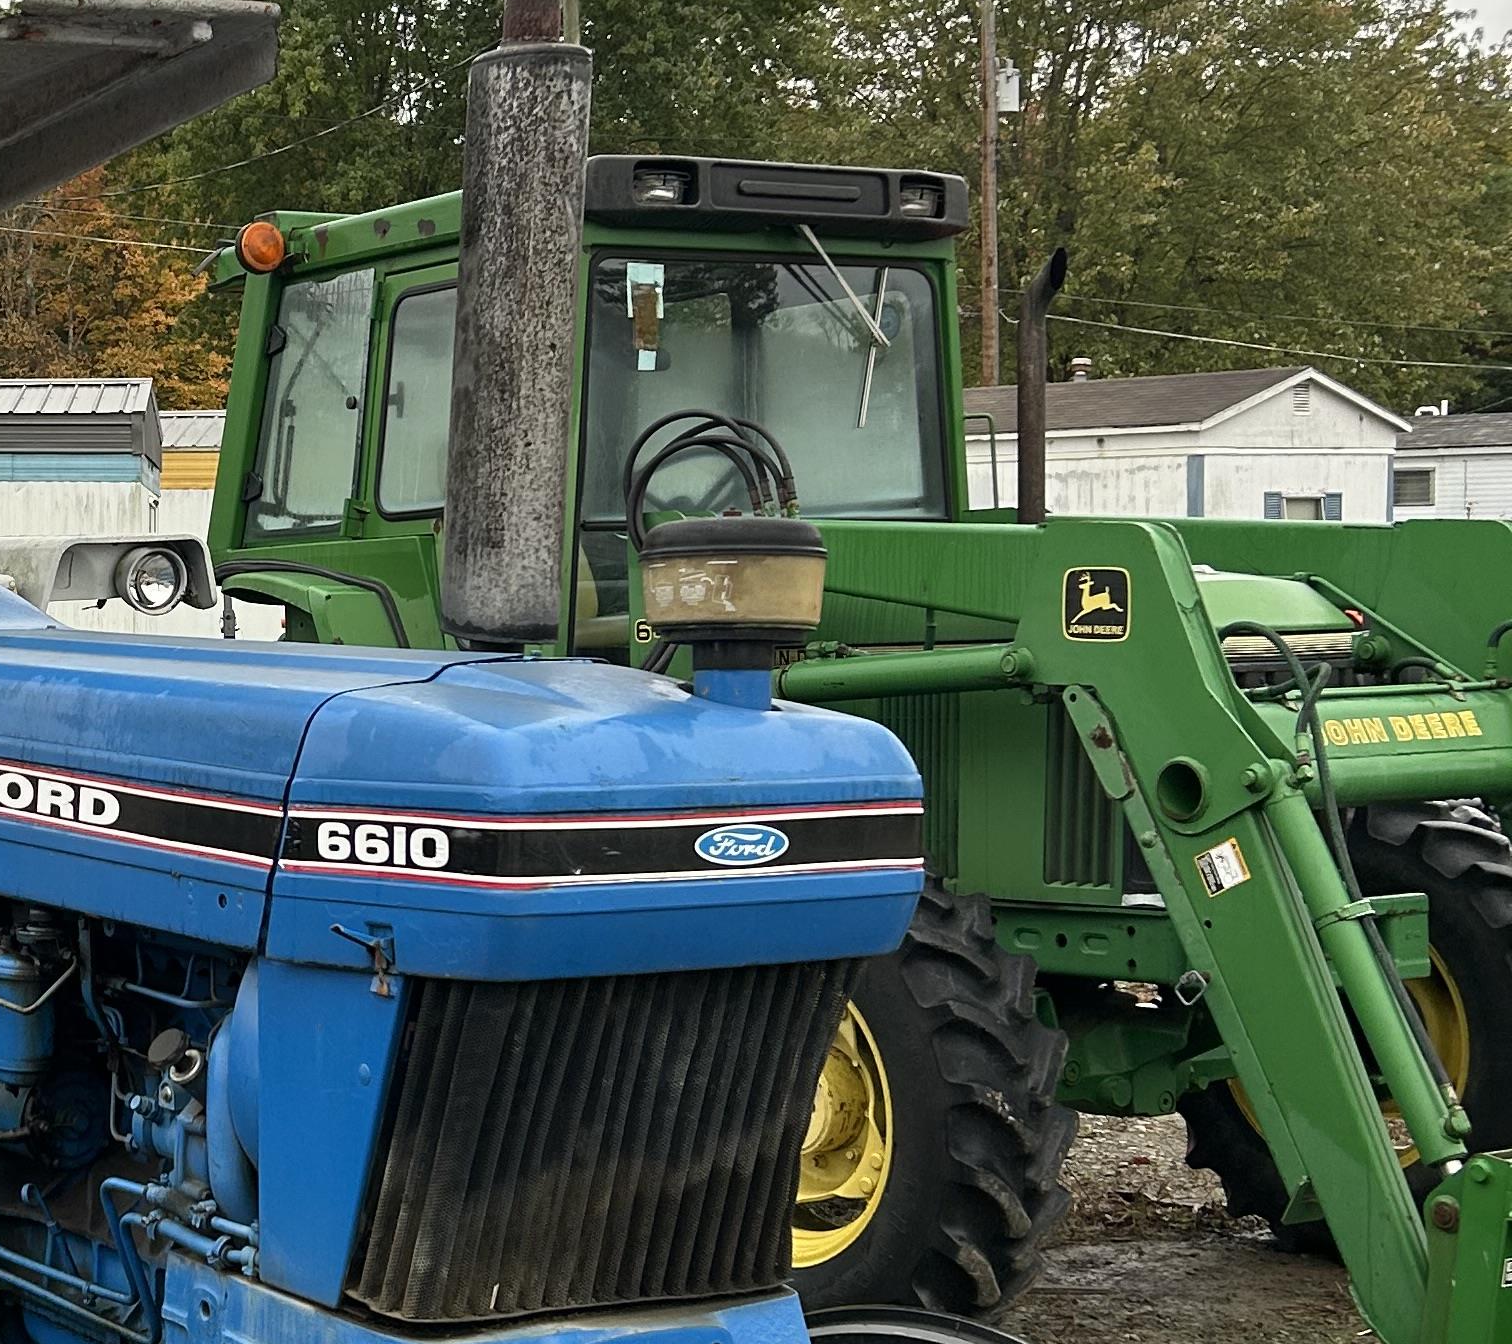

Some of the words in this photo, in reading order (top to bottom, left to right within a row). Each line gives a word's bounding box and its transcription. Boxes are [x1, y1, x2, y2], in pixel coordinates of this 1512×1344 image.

[1068, 624, 1092, 634] JOHN
[1093, 625, 1124, 635] DEERE
[1388, 709, 1483, 742] DEERE
[317, 821, 450, 868] 6610
[709, 832, 776, 856] Ford
